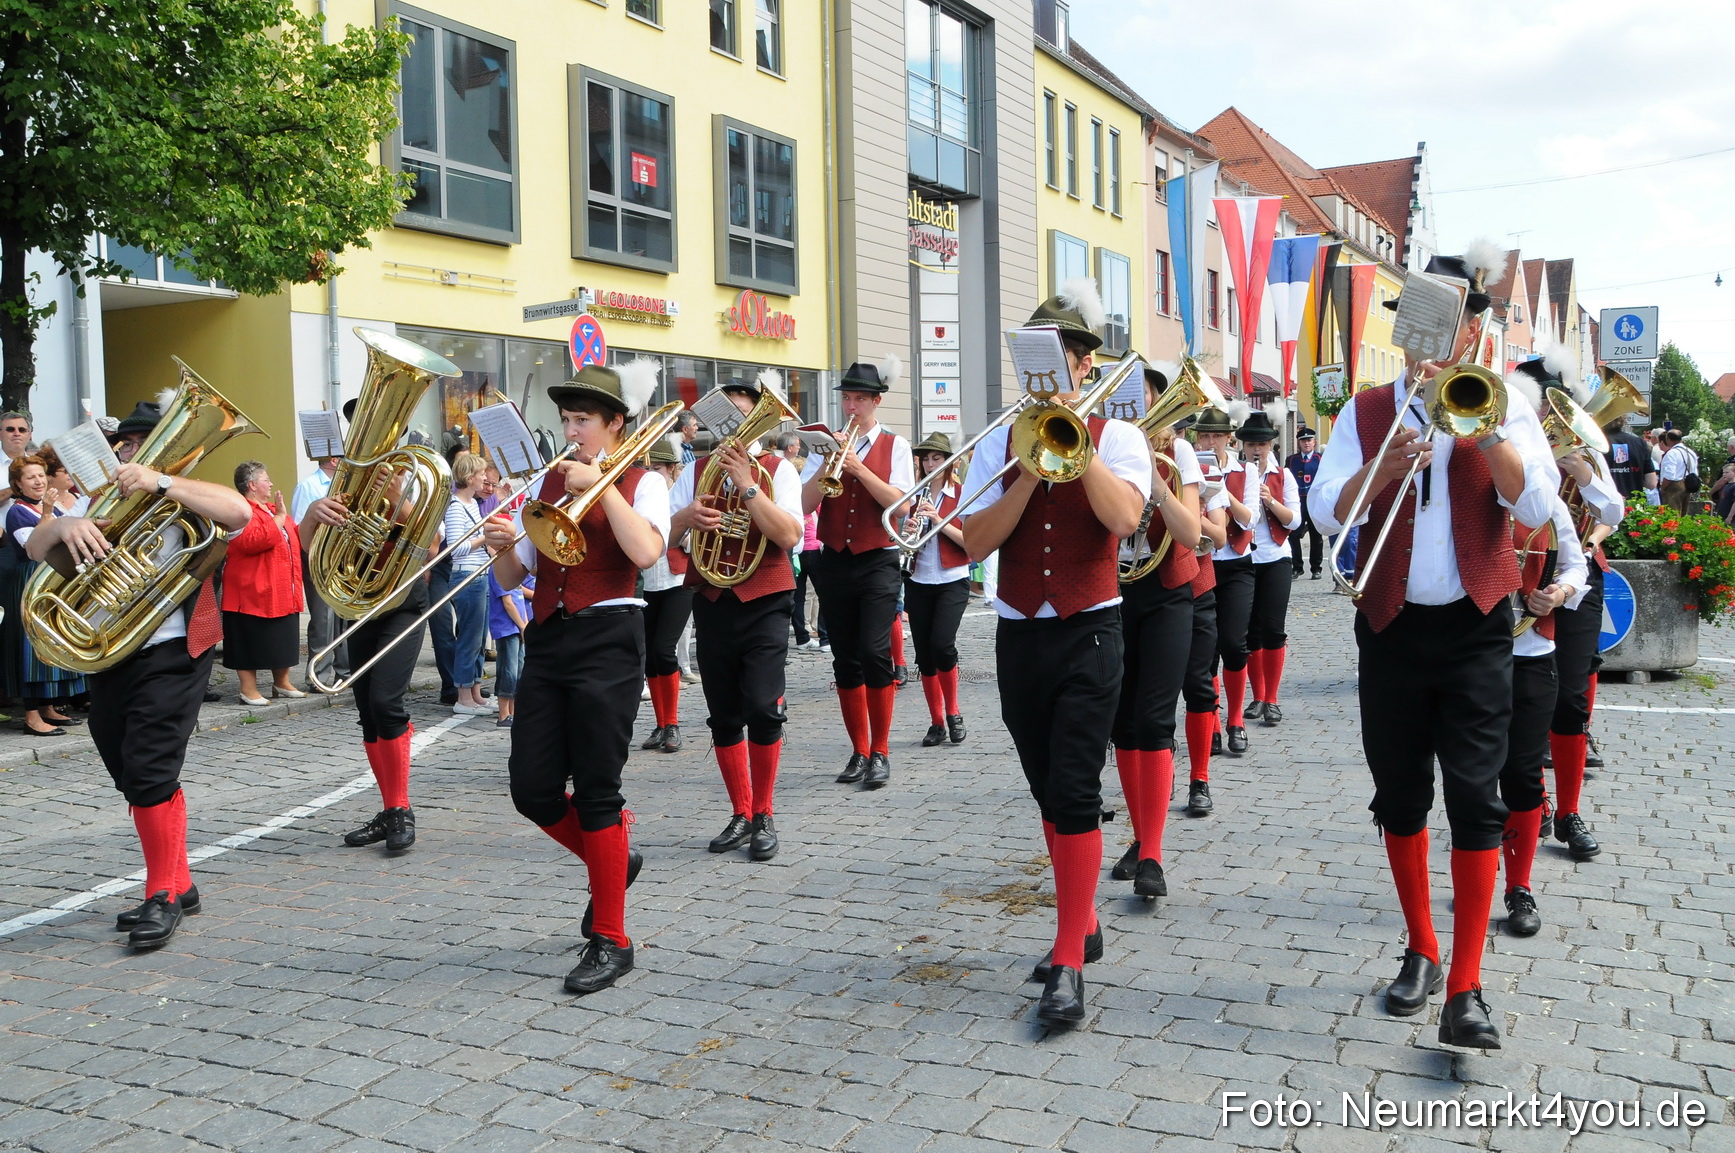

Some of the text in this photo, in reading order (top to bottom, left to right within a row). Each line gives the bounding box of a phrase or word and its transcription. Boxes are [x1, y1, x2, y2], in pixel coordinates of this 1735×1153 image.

[908, 189, 957, 232] altstadt
[595, 289, 607, 306] IL
[609, 291, 665, 314] GOLOSONE
[524, 302, 578, 320] Brunnwirtsgasse
[730, 289, 798, 341] s.Oliver
[1614, 346, 1642, 356] ZONE
[1614, 365, 1649, 373] ferverkehr
[1627, 414, 1635, 422] ei
